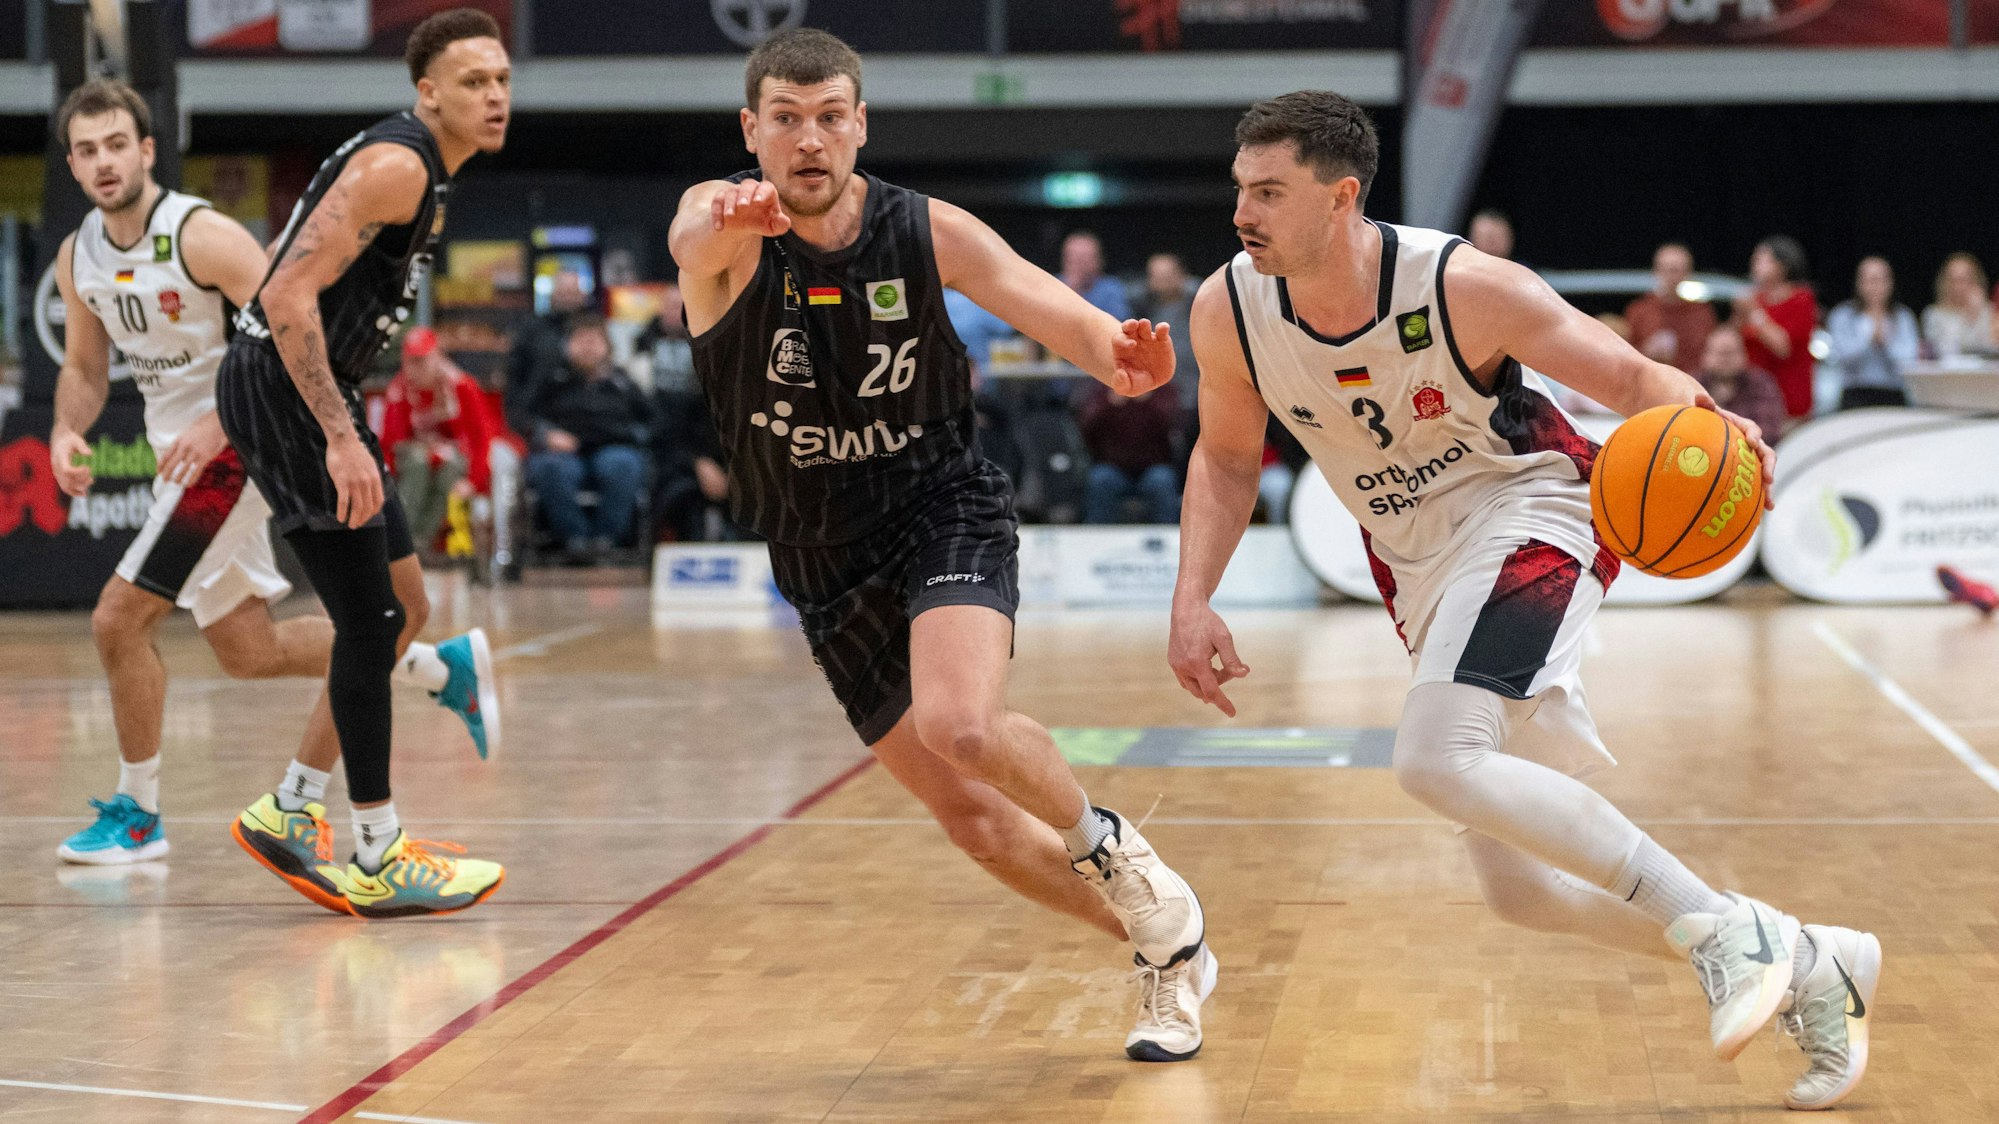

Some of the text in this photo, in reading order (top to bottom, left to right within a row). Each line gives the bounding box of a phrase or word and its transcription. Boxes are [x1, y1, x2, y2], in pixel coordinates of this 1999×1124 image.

[112, 293, 148, 334] 10
[781, 338, 808, 353] BRA
[857, 337, 919, 397] 26
[1351, 397, 1394, 450] 3
[1700, 437, 1757, 539] Wilson
[926, 573, 972, 586] CRAFT
